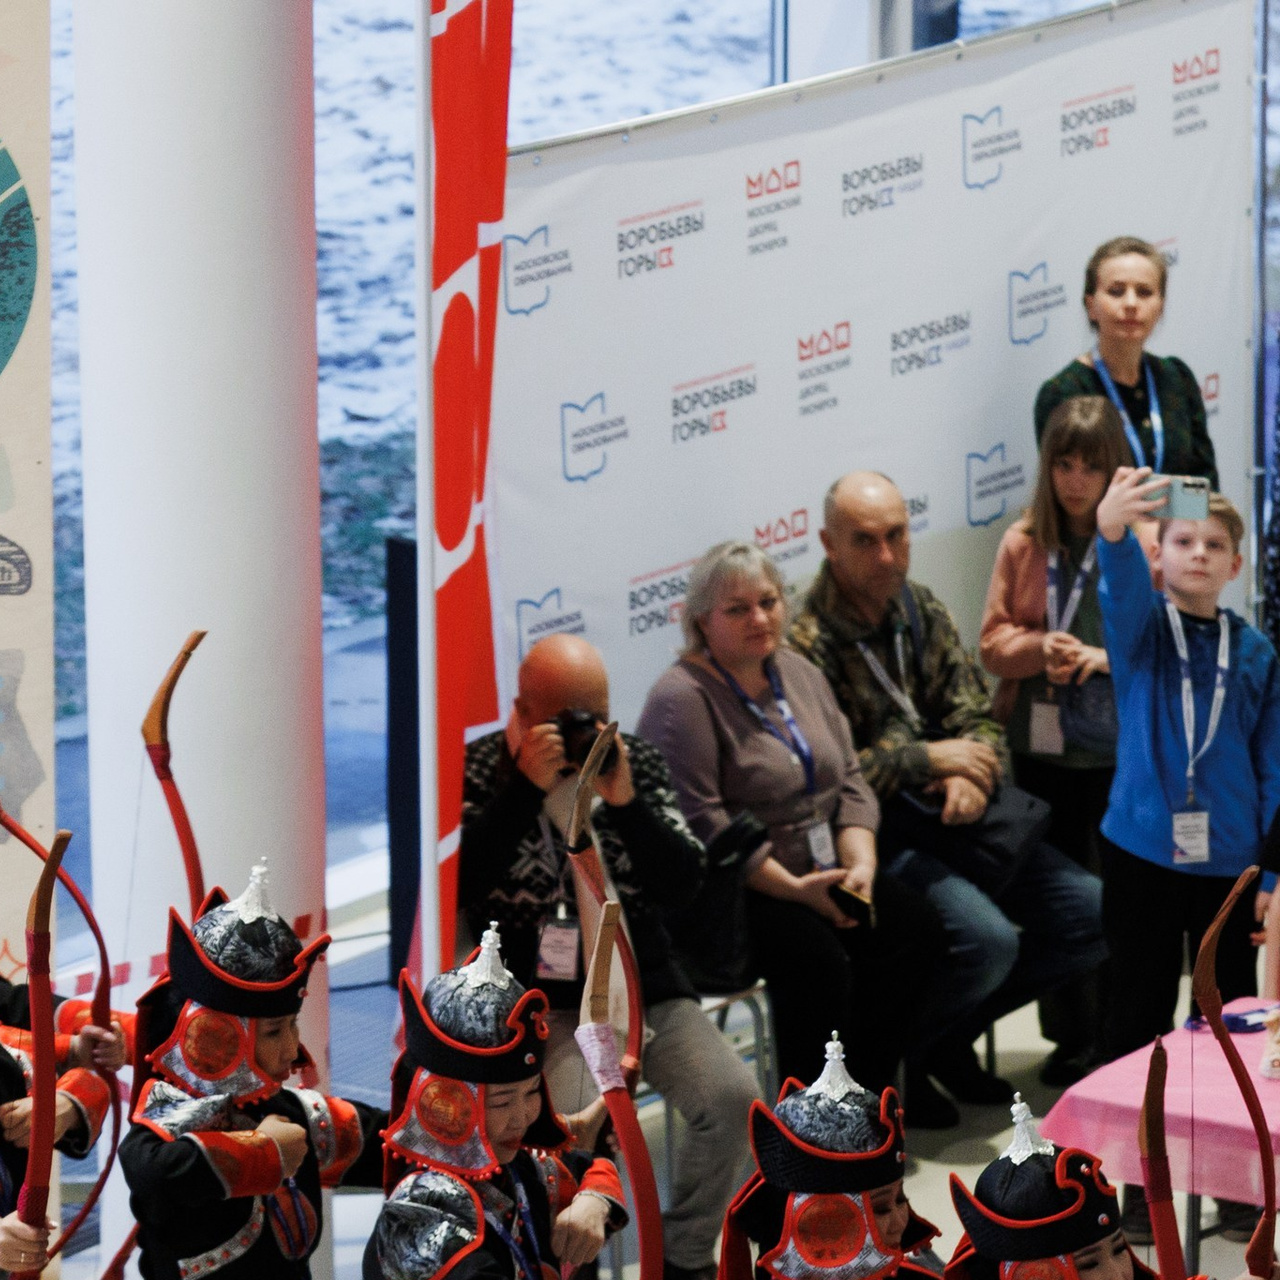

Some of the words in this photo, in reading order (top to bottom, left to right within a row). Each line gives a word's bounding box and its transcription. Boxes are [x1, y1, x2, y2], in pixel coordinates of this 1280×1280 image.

[1061, 130, 1095, 157] ГОРЫ
[842, 154, 923, 192] ВОРОБЬЕВЫ
[842, 190, 880, 218] ГОРЫ
[617, 213, 704, 252] ВОРОБЬЕВЫ
[618, 251, 657, 280] ГОРЫ
[891, 311, 971, 352] ВОРОБЬЕВЫ
[891, 349, 926, 377] ГОРЫ
[672, 374, 757, 417] ВОРОБЬЕВЫ
[672, 415, 711, 444] ГОРЫ
[629, 608, 670, 638] ГОРЫ
